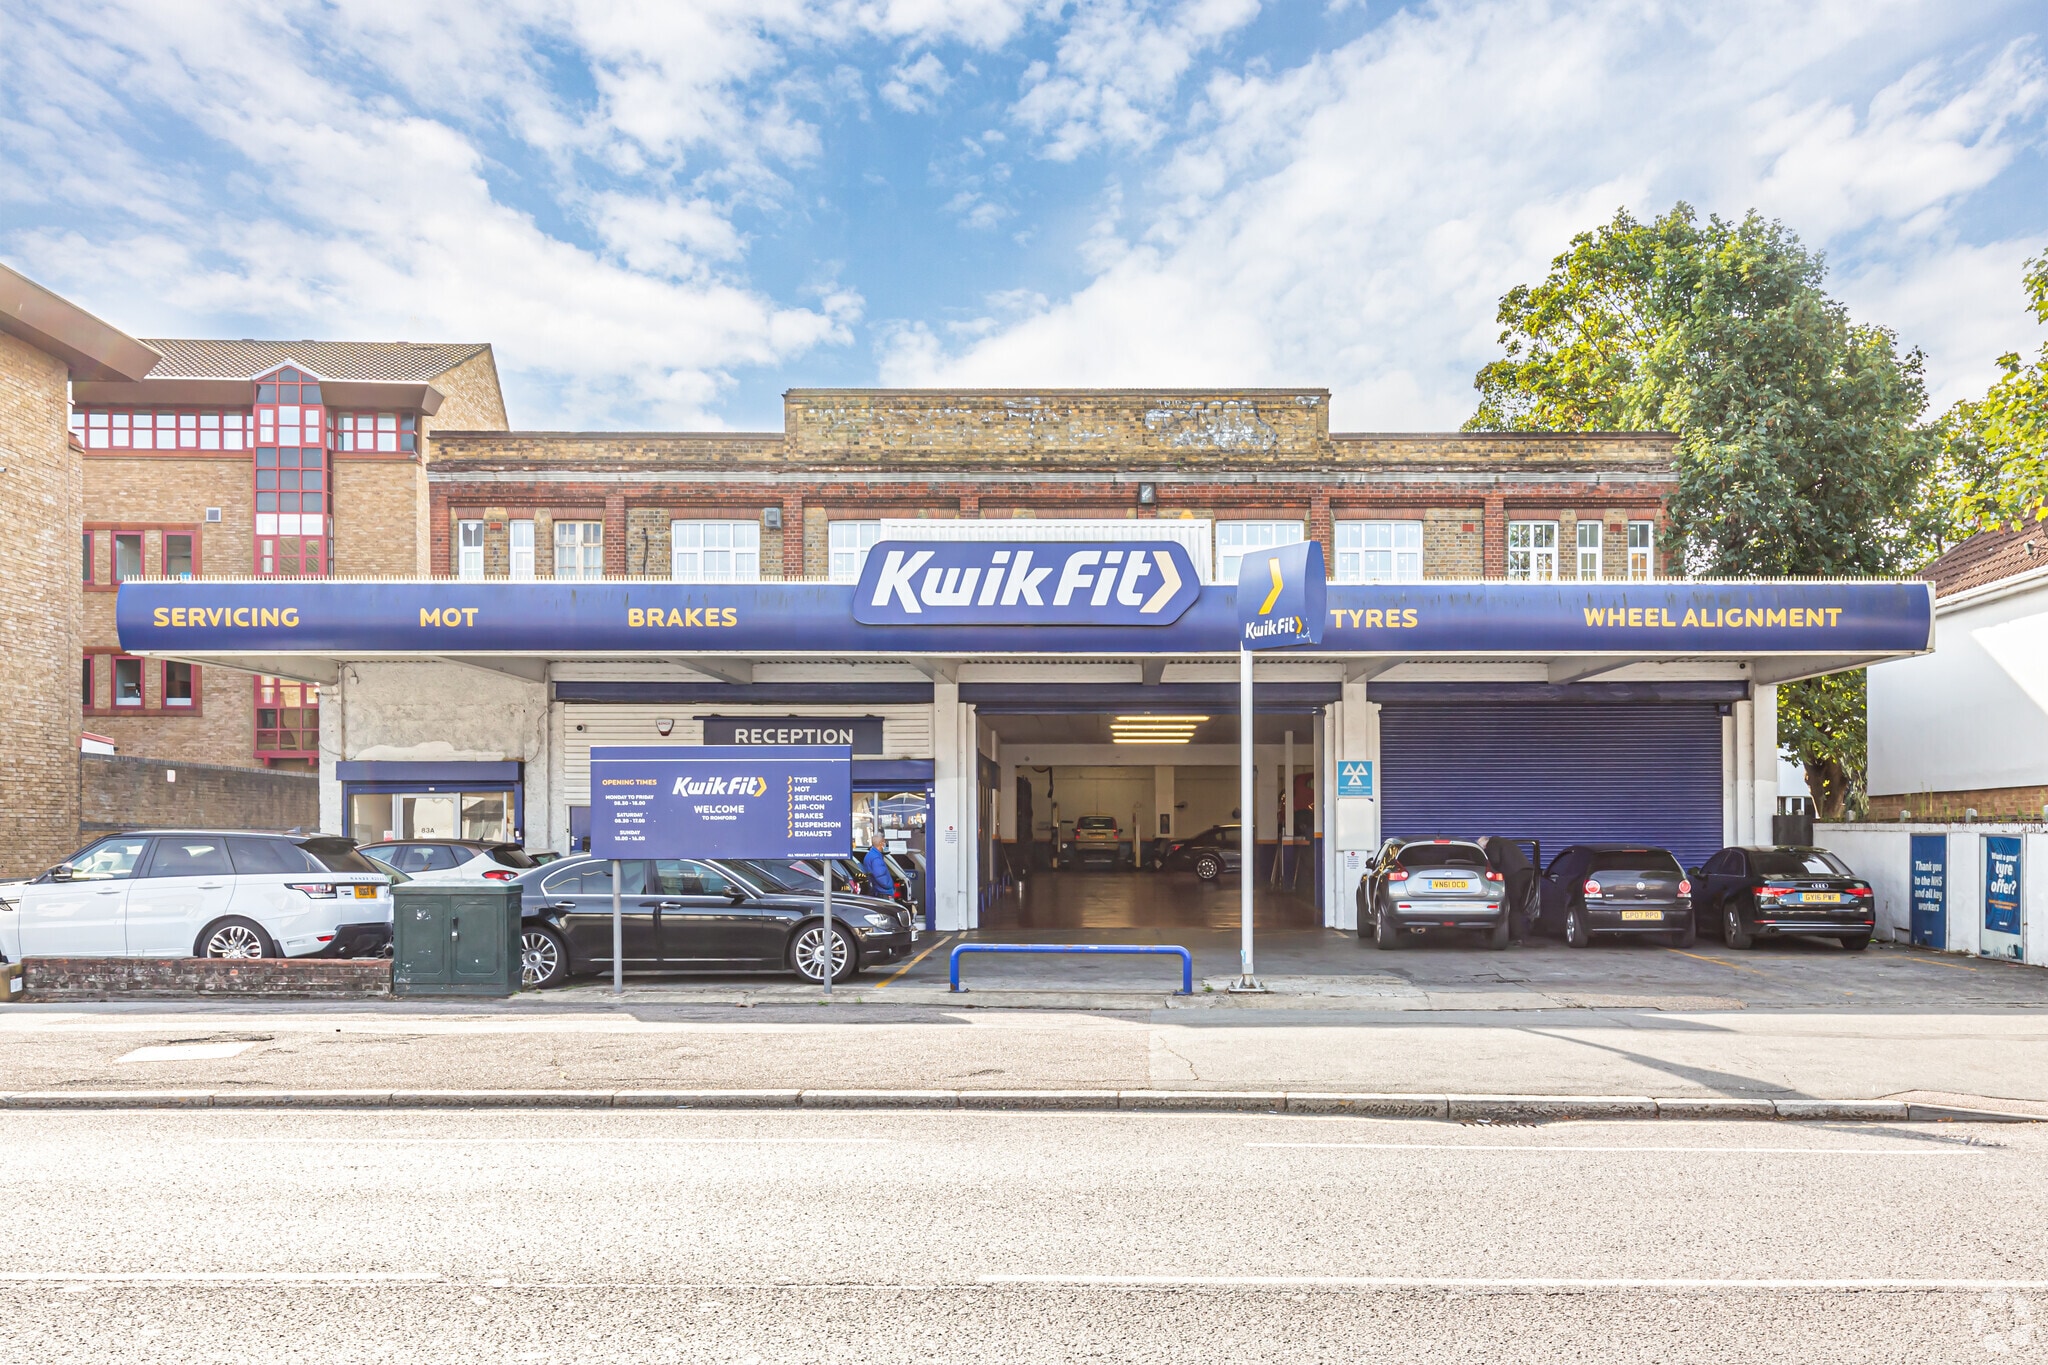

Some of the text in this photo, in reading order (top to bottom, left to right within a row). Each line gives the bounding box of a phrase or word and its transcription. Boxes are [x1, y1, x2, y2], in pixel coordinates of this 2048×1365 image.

[871, 550, 1155, 614] Kwik Fit
[153, 606, 300, 629] SERVICING
[419, 607, 479, 628] MOT
[627, 607, 738, 629] BRAKES
[1330, 608, 1419, 629] TYRES
[1584, 607, 1843, 628] WHEEL ALIGNMENT
[1245, 616, 1295, 640] Kwik Fit
[735, 728, 854, 744] RECEPTION
[672, 776, 758, 797] Kwik Fit
[794, 776, 818, 784] TYRES
[794, 794, 833, 802] SERVICING
[693, 804, 745, 814] WELCOME
[794, 803, 825, 811] AIR-CON
[794, 812, 824, 820] BRAKES
[794, 821, 841, 829] SUSPENSION
[1915, 860, 1942, 874] Thank you
[1995, 860, 2013, 878] tyre
[1915, 876, 1943, 886] to the NHS
[1990, 878, 2017, 895] offer?
[1915, 888, 1943, 902] and all key
[1918, 901, 1940, 912] workers
